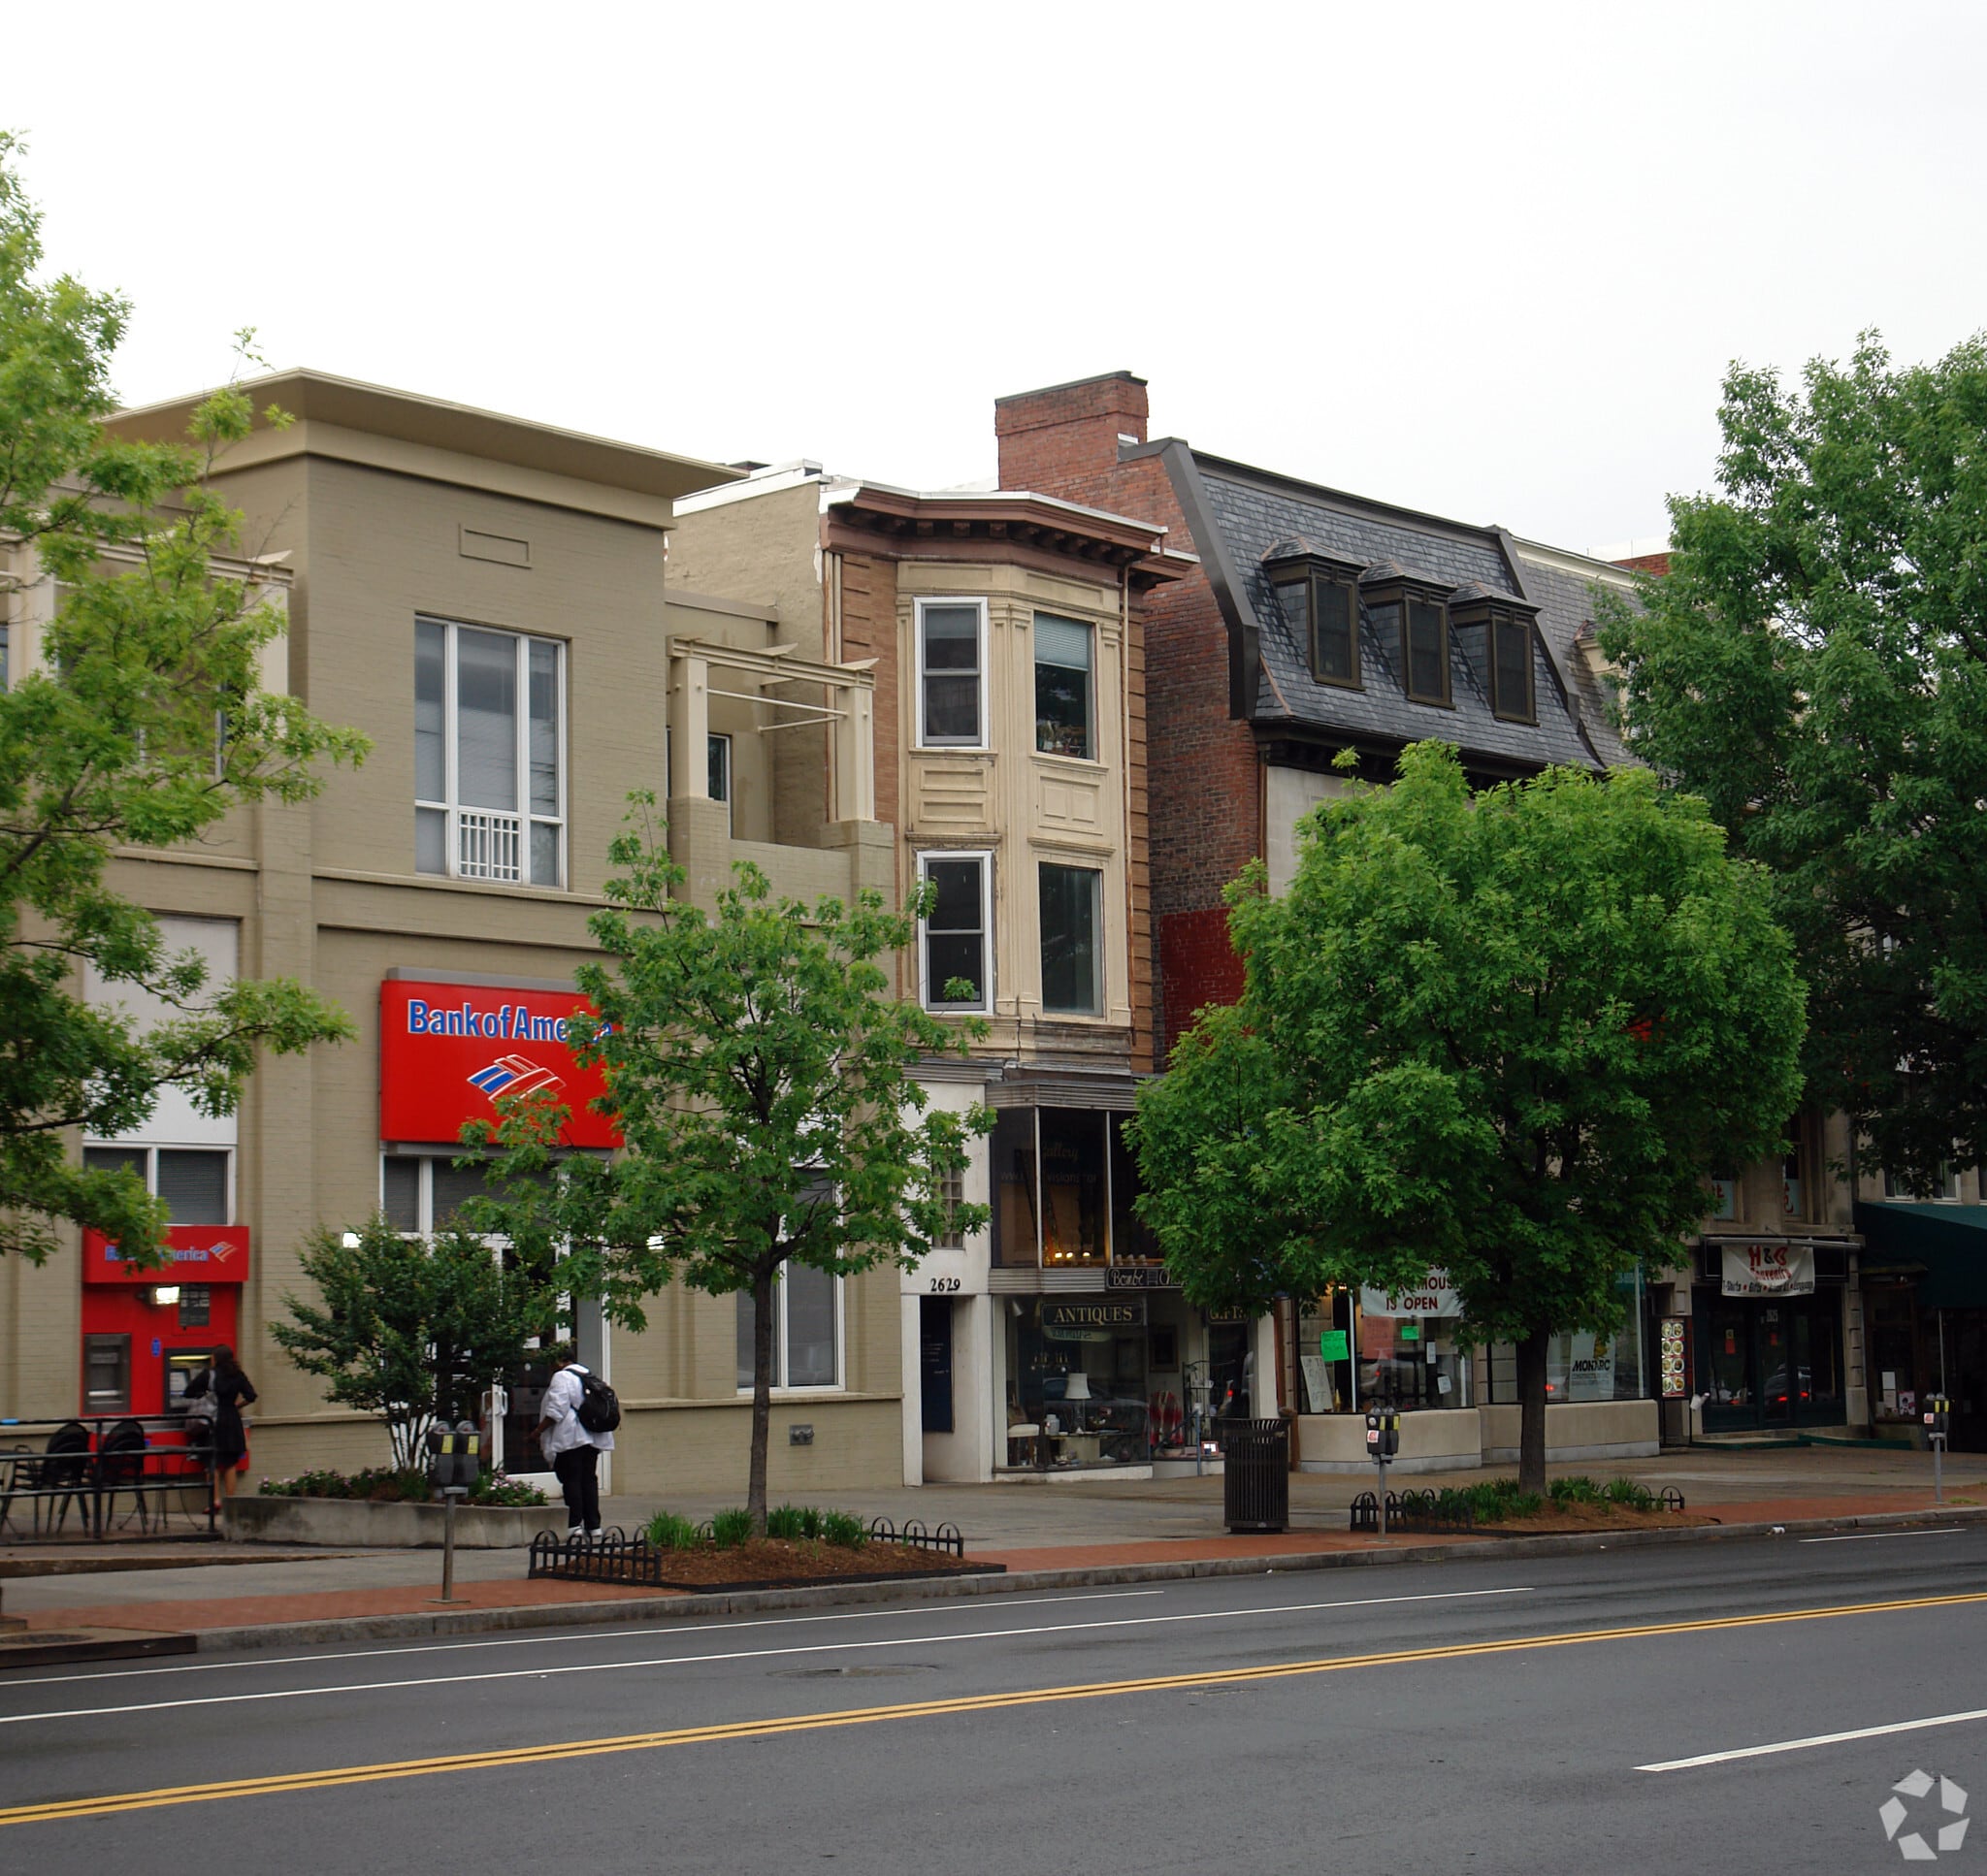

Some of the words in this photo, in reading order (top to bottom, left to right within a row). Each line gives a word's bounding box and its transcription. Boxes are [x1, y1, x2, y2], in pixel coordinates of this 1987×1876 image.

[930, 1278, 961, 1292] 2629
[1385, 1297, 1397, 1310] IS
[1403, 1296, 1439, 1310] OPEN
[1054, 1306, 1133, 1326] ANTIQUES
